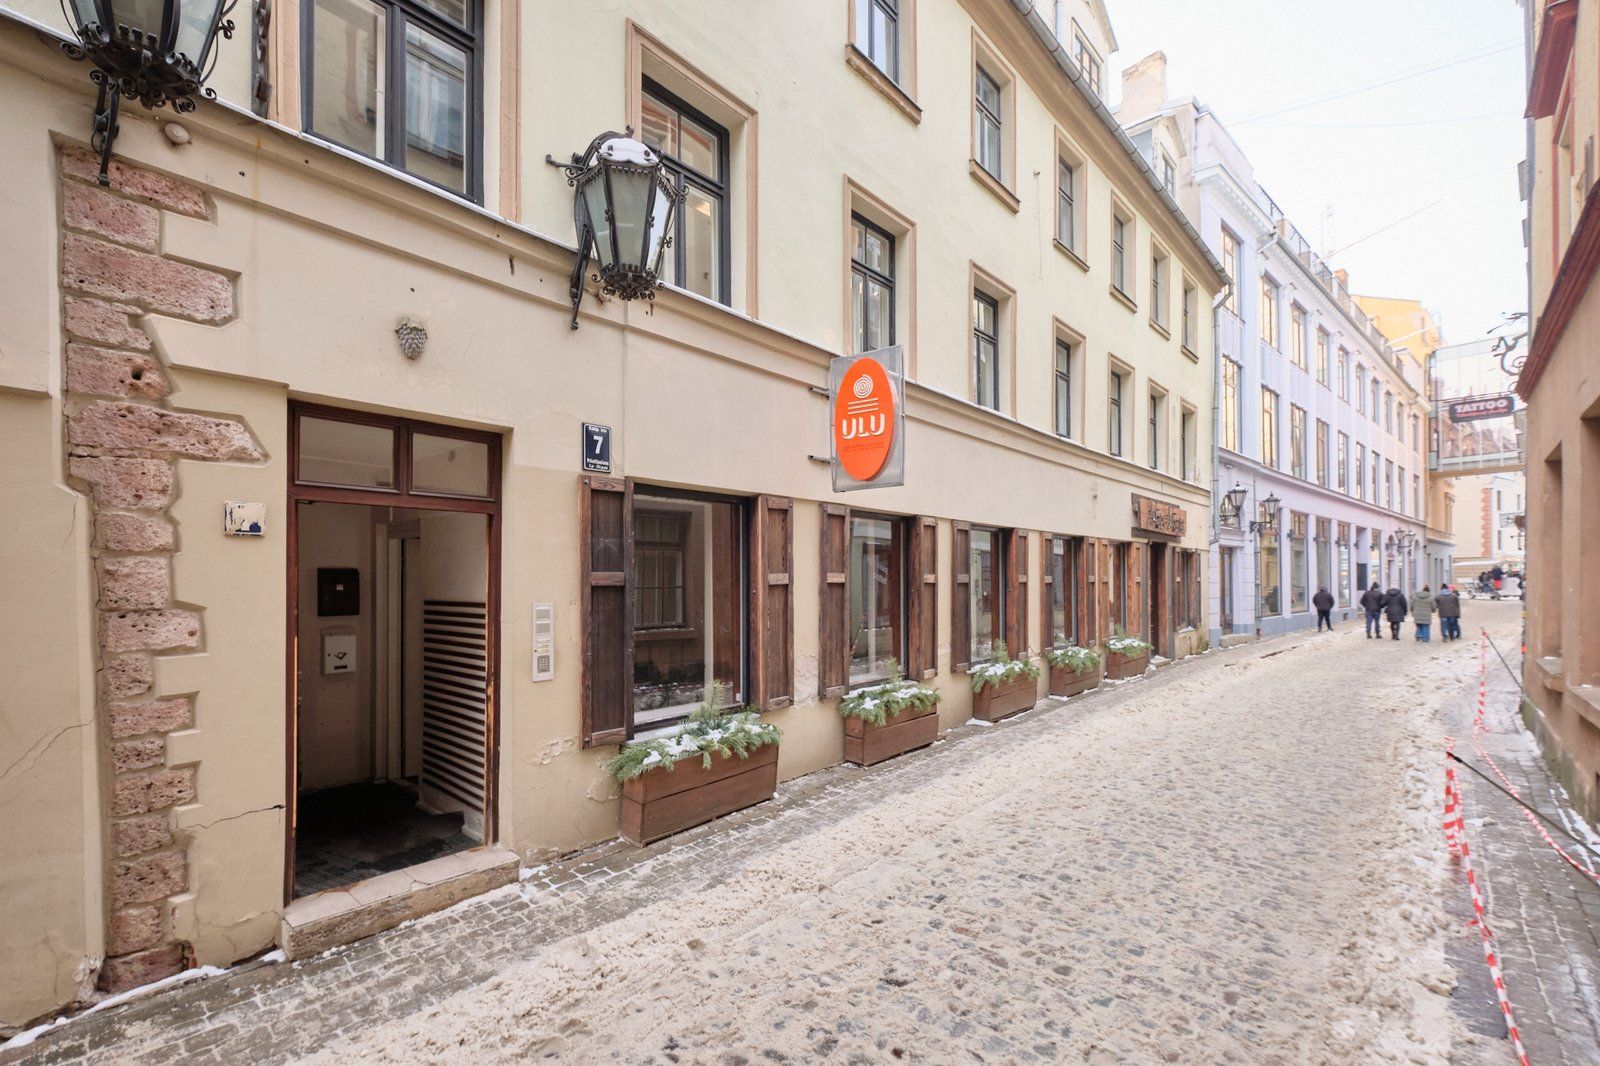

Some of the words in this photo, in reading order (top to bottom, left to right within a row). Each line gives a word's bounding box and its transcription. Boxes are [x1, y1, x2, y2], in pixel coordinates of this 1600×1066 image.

[1454, 399, 1508, 413] TATTOO
[841, 413, 886, 440] ULU
[593, 435, 604, 455] 7
